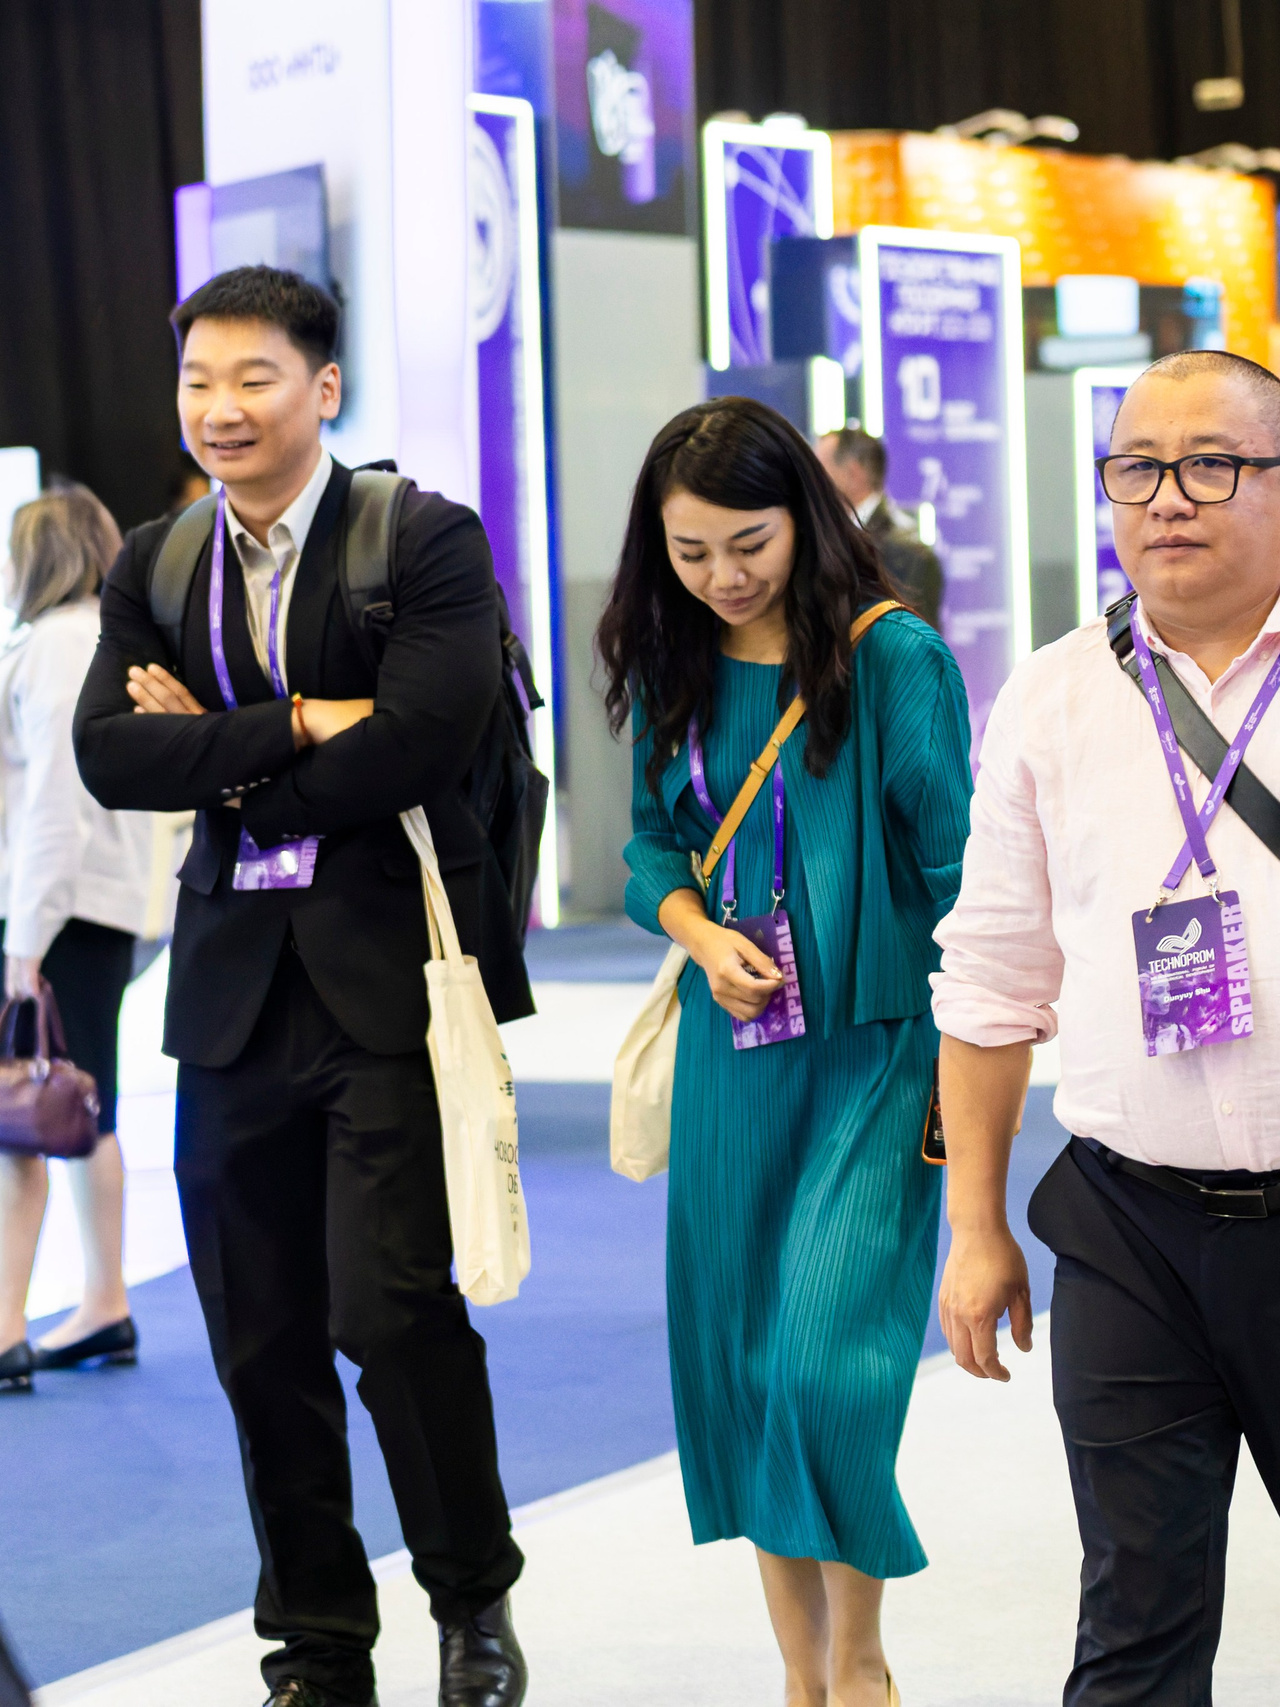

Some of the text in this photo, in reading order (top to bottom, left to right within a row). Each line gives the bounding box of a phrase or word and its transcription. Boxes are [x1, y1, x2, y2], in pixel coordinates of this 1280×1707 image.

[775, 919, 805, 1035] SPECIAL
[1148, 948, 1215, 974] TECHNOPROM
[1220, 903, 1254, 1036] SPEAKER
